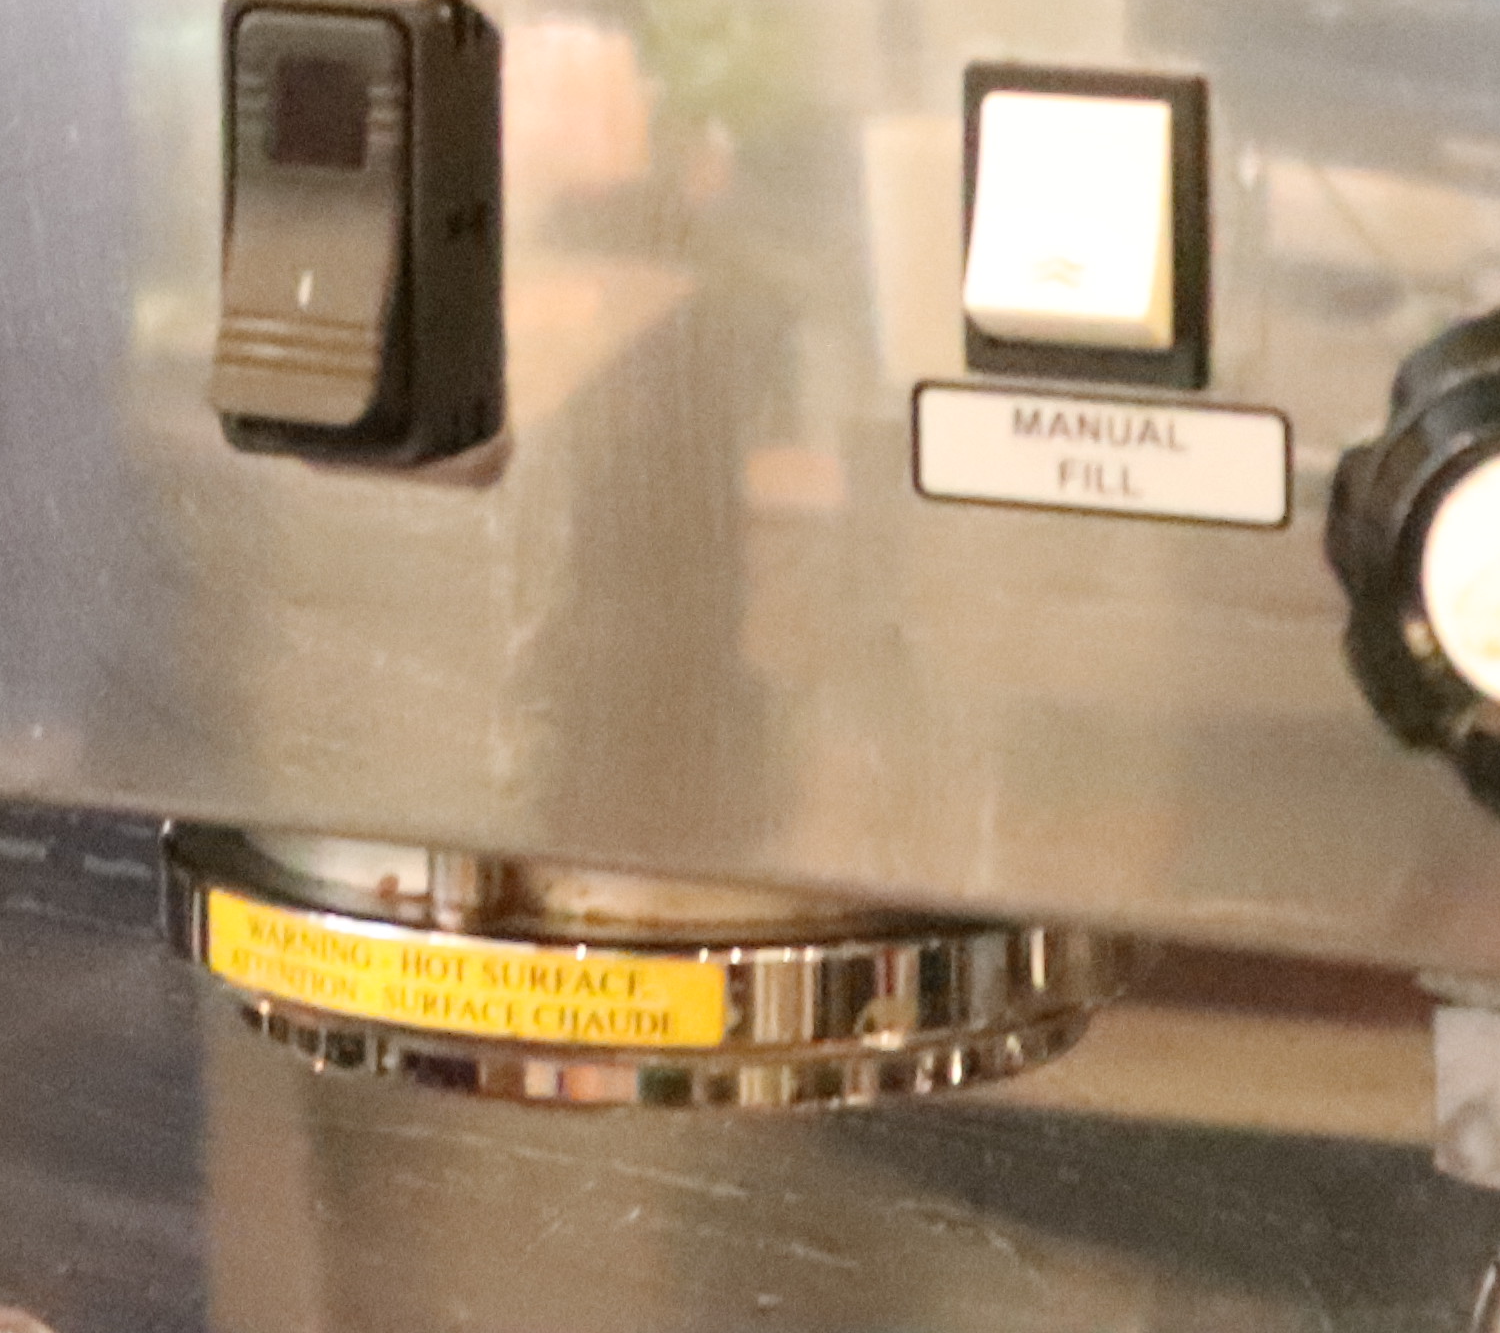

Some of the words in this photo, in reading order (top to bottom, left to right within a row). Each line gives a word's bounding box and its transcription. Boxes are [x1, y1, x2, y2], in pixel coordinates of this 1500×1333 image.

[1013, 407, 1188, 453] MANUAL
[1057, 459, 1144, 500] FILL
[247, 913, 371, 970] WARNING
[401, 947, 465, 983] HOT
[482, 958, 648, 998] SURFACE
[384, 983, 520, 1028] SURFACE
[533, 1002, 676, 1036] CHAUDE
